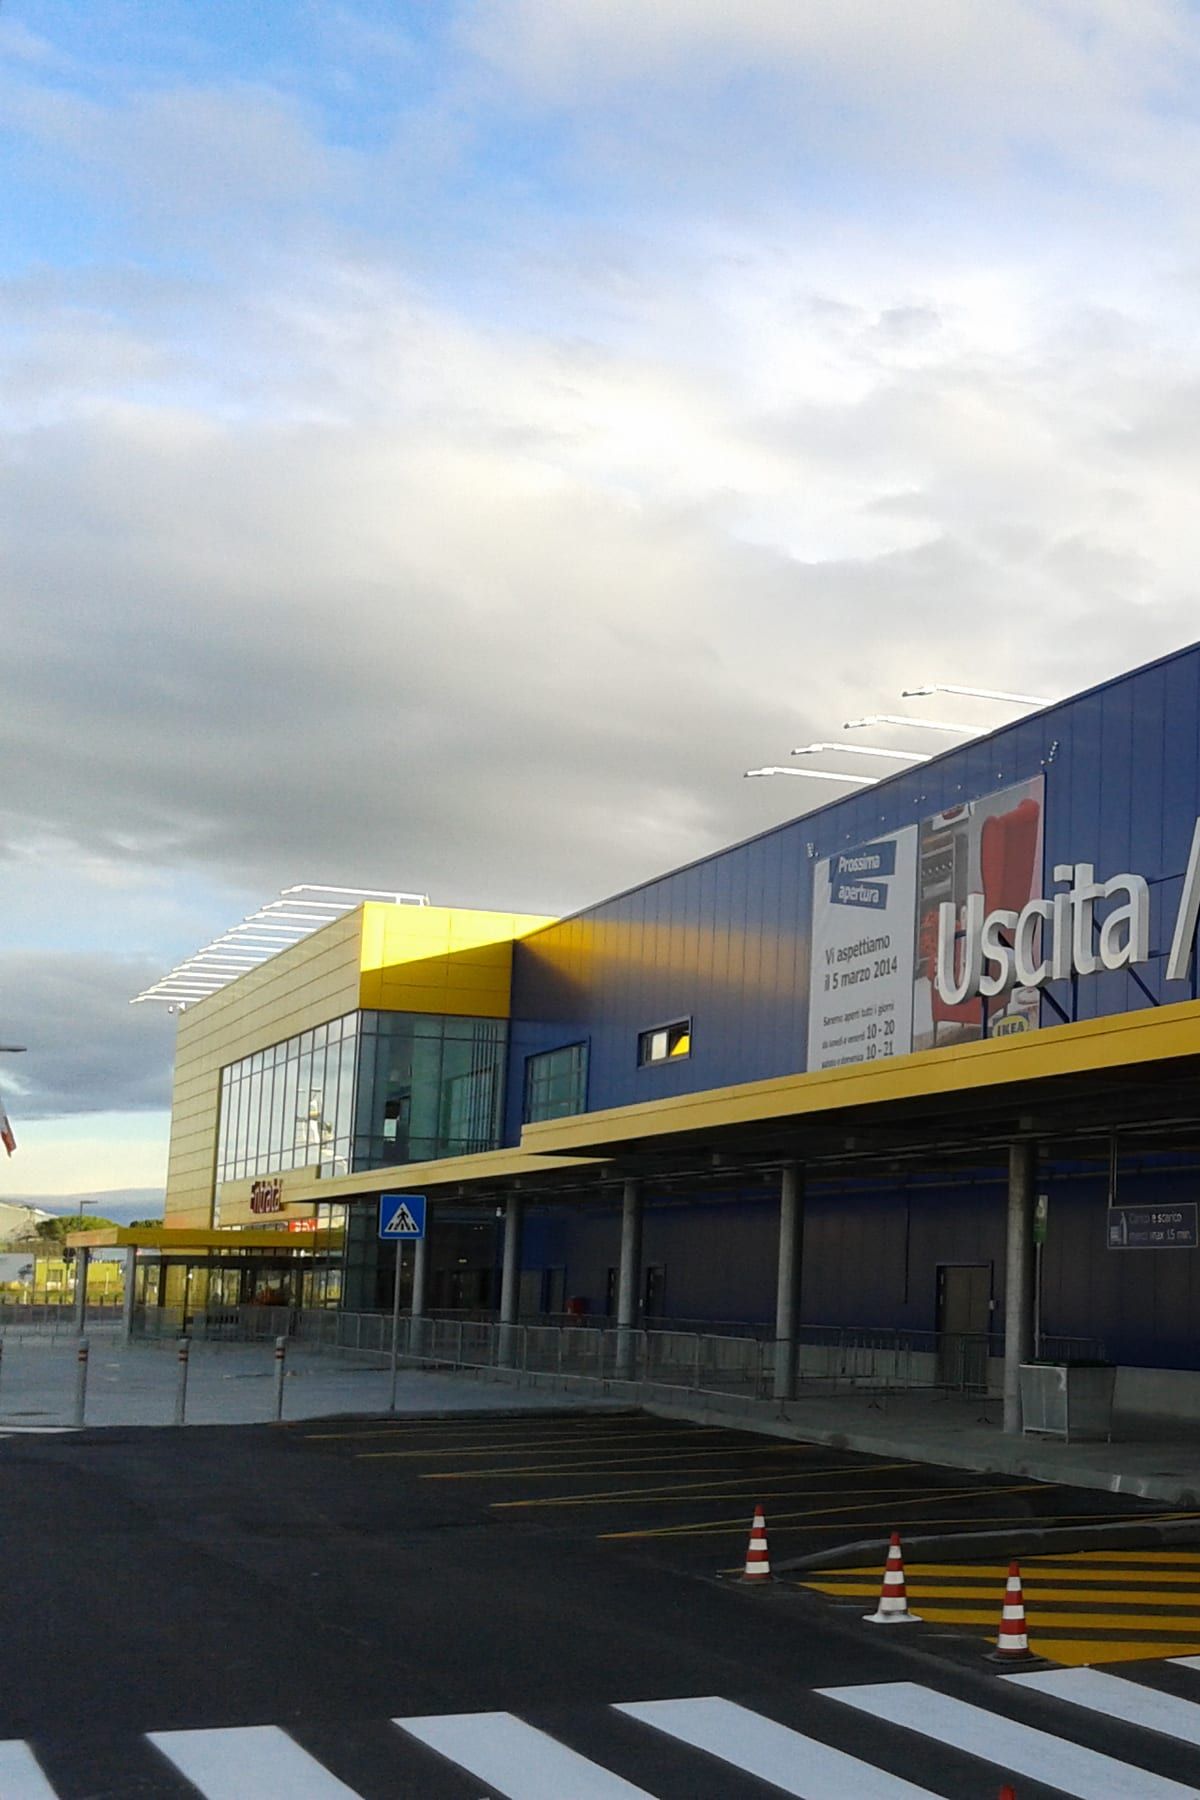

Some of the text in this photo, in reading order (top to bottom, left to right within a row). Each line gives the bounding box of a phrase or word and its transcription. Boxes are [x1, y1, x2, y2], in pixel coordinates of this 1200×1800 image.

[838, 852, 880, 873] Prossima
[838, 884, 880, 904] apertura
[938, 863, 1149, 1005] Uscita
[825, 935, 890, 965] Vi aspettiamo
[832, 972, 839, 990] 5
[841, 967, 871, 987] marzo
[874, 955, 898, 978] 2014
[867, 1023, 877, 1040] 10
[884, 1018, 895, 1036] 20
[998, 1021, 1025, 1037] IKEA
[866, 1043, 877, 1060] 10
[883, 1040, 894, 1057] 21
